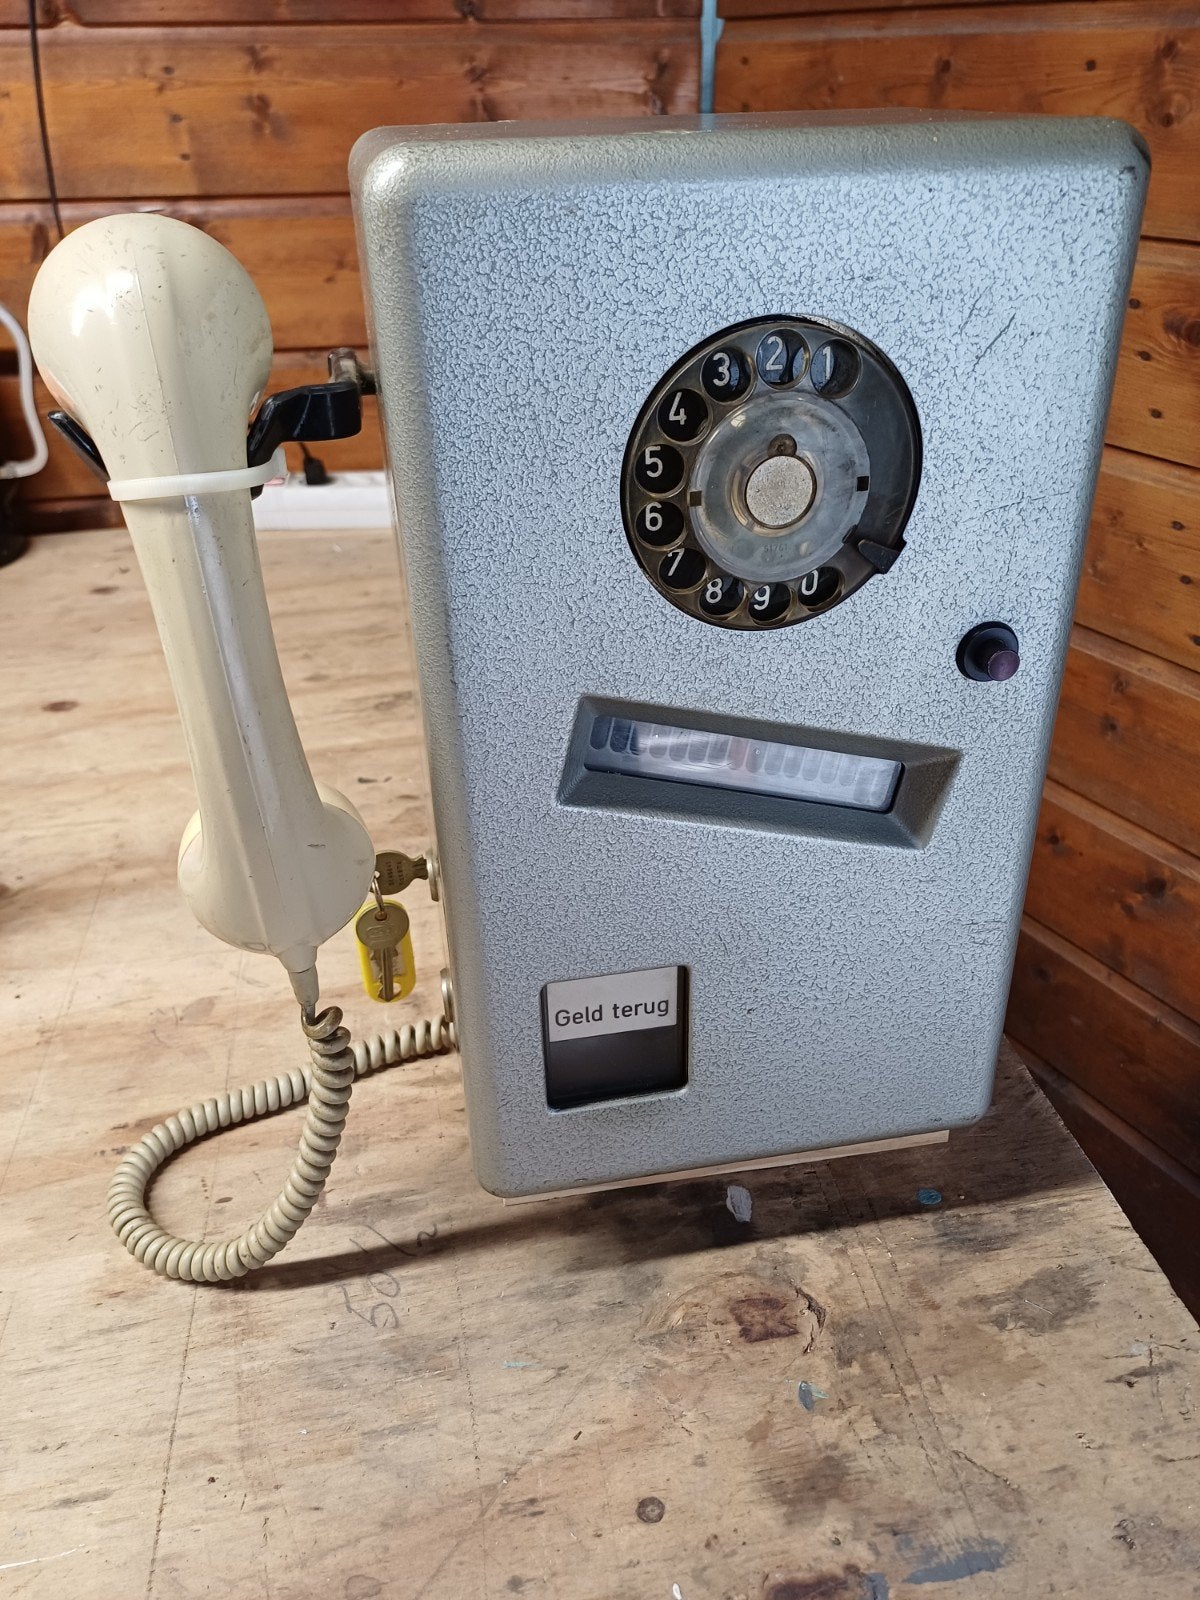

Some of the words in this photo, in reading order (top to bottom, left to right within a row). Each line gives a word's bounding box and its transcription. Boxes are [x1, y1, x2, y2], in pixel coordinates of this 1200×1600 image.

[765, 336, 784, 371] 2
[822, 346, 833, 380] 1
[712, 352, 730, 387] 3
[668, 391, 687, 426] 4
[644, 446, 663, 478] 5
[645, 502, 663, 531] 6
[667, 548, 685, 577] 7
[705, 578, 722, 604] 8
[801, 570, 818, 596] 0
[753, 585, 770, 611] 9
[555, 1004, 603, 1027] Geld
[612, 999, 669, 1019] terug
